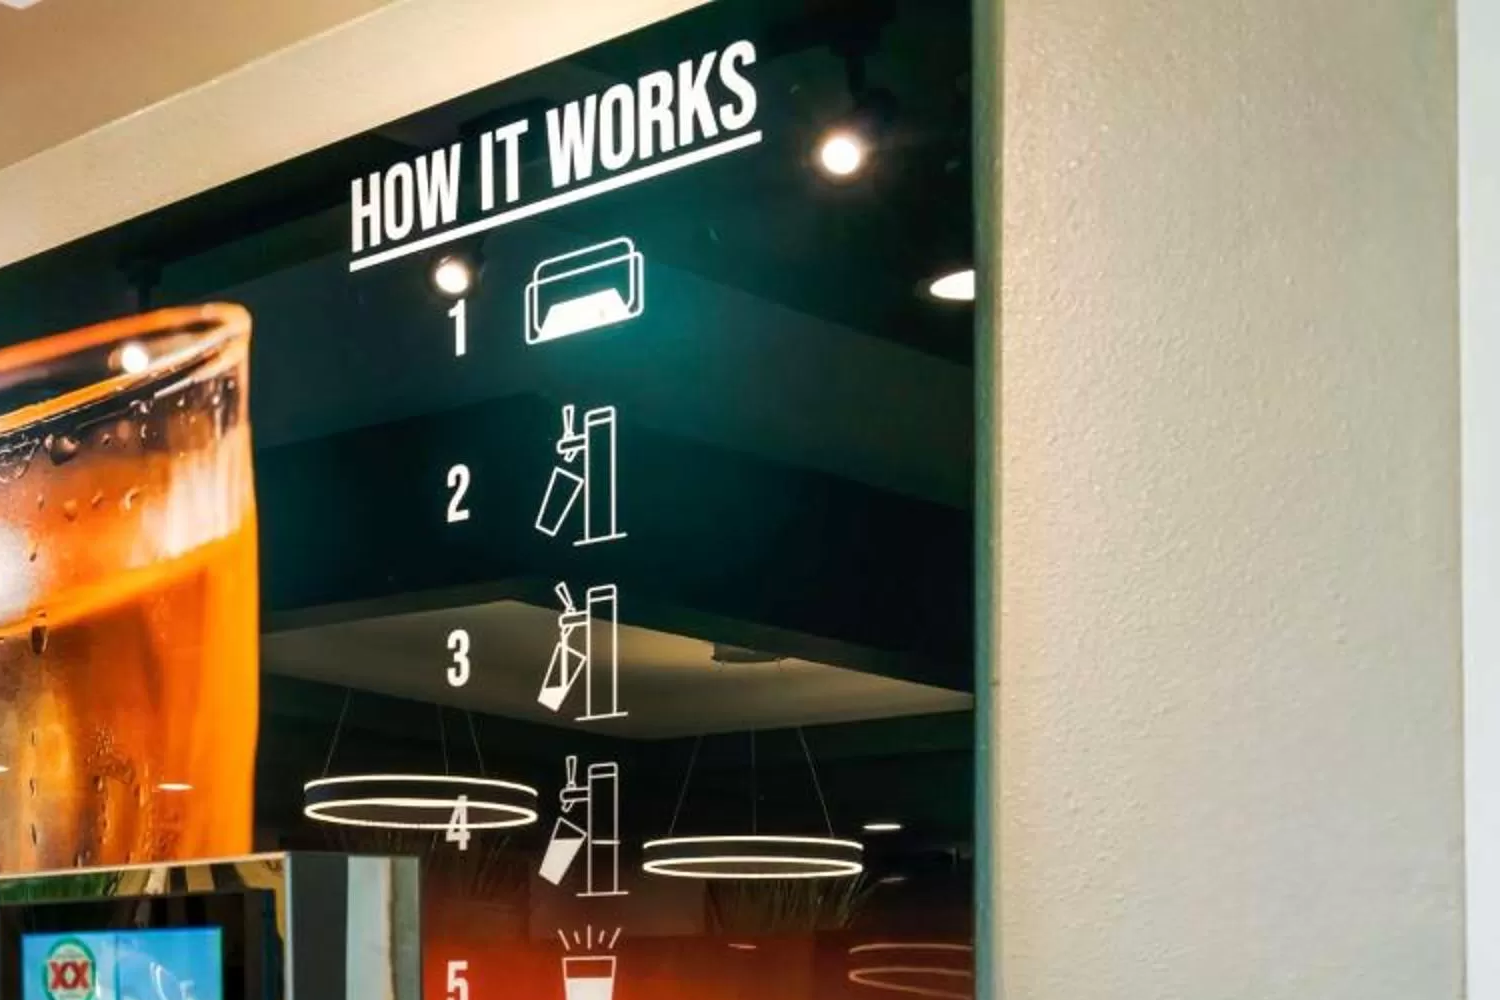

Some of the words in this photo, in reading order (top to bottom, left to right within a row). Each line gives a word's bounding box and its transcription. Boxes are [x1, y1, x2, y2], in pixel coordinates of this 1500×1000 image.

[350, 143, 461, 253] HOW
[479, 119, 529, 211] IT
[545, 39, 757, 189] WORKS
[447, 298, 467, 357] 1
[446, 463, 471, 523] 2
[446, 628, 471, 687] 3
[445, 794, 471, 851] 4
